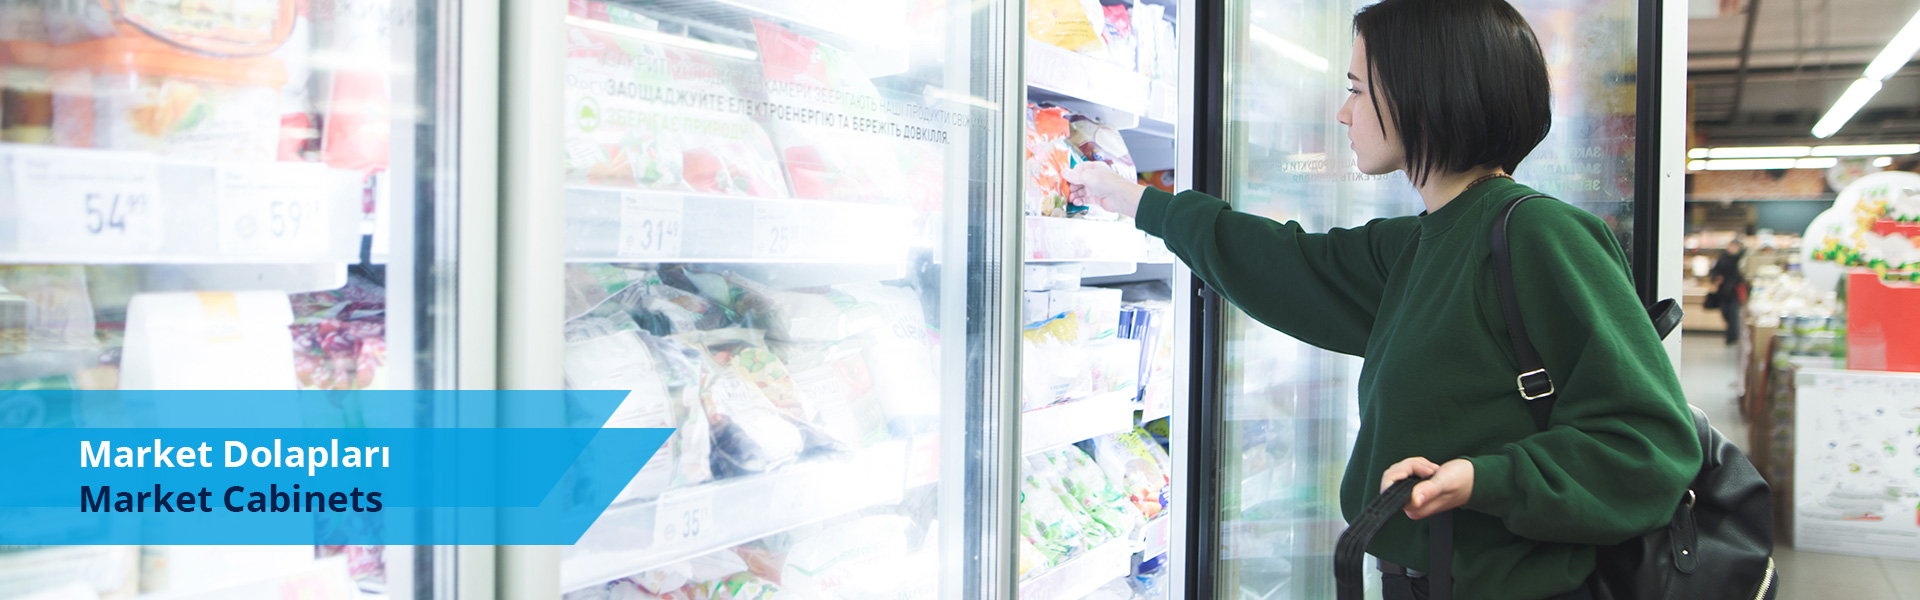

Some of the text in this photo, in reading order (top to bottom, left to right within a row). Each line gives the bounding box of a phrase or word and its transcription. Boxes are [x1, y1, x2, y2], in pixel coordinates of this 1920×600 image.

[728, 97, 835, 128] ЕЛЕКТРОЕНЕРГІЮ
[837, 114, 850, 129] ТА
[852, 116, 902, 137] БЕРЕЖІТЬ
[813, 85, 878, 112] ЗБЕРІГАЮТЬ
[905, 104, 951, 126] ПРОДУКТИ
[84, 192, 126, 235] 54
[269, 200, 302, 239] 59
[638, 219, 664, 252] 31
[768, 226, 789, 255] 25
[682, 508, 700, 539] 35
